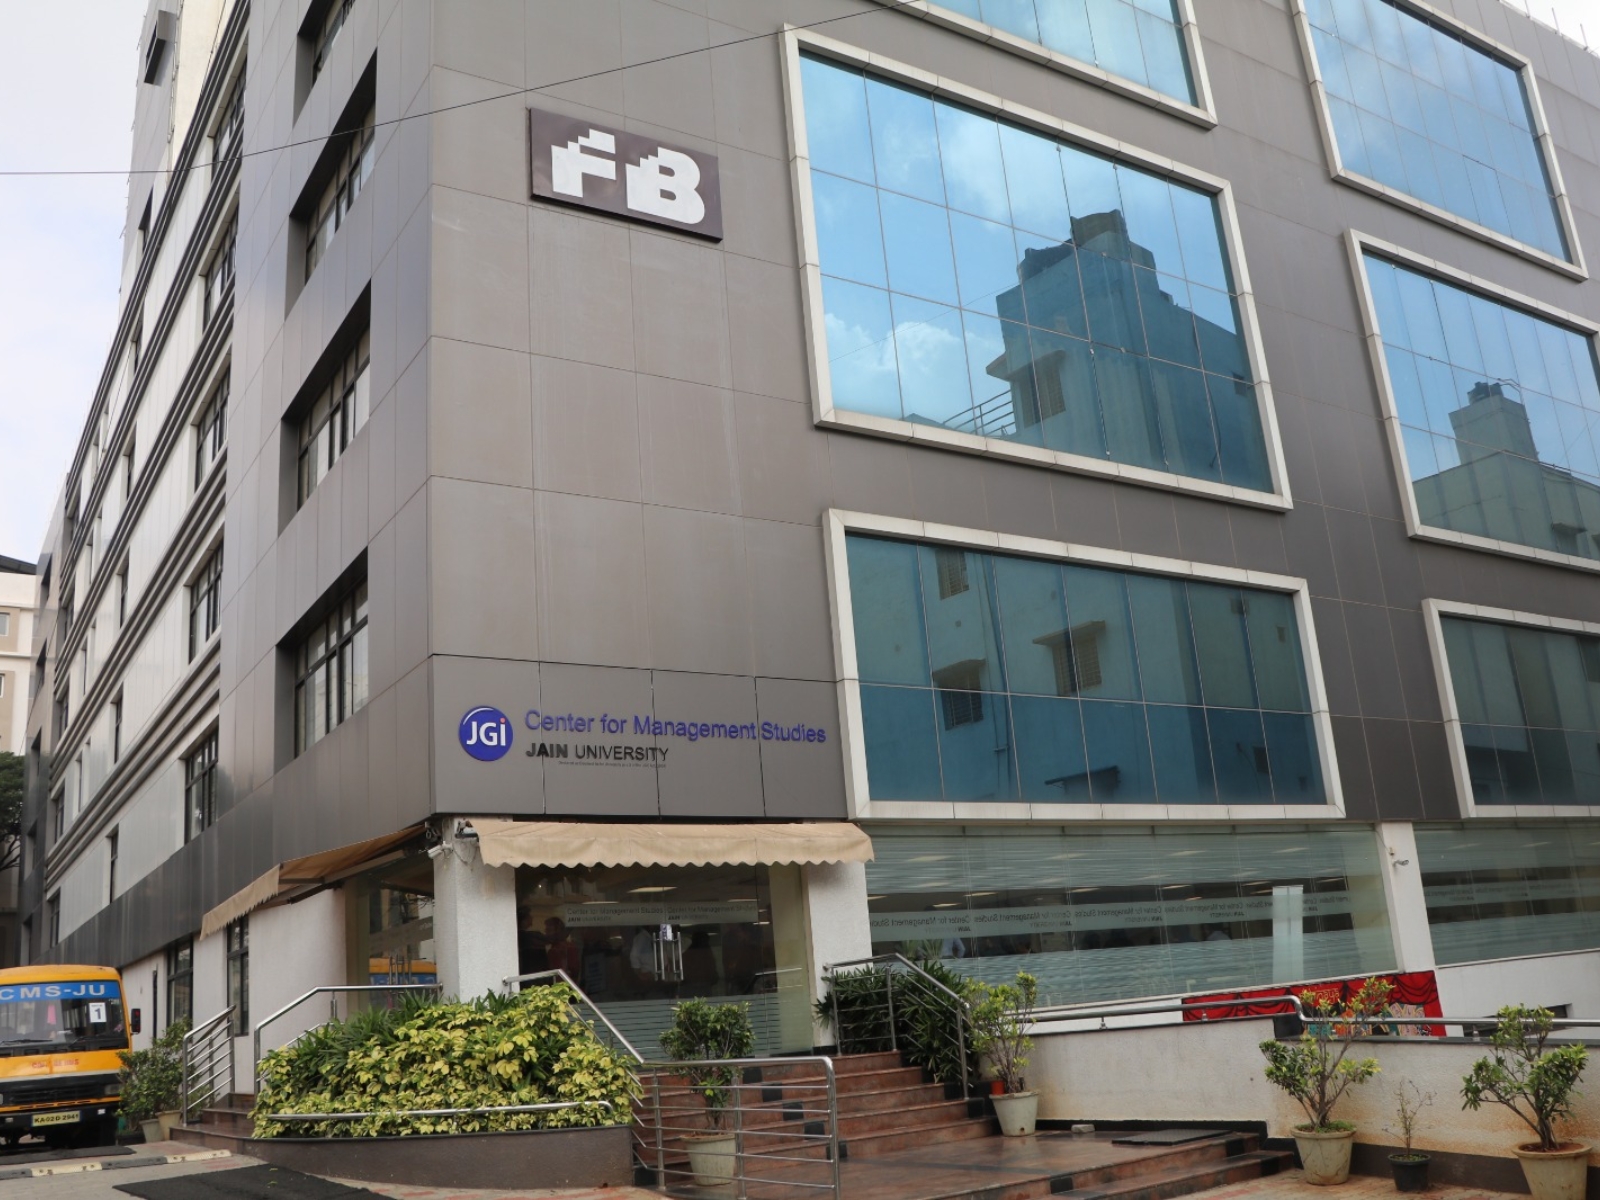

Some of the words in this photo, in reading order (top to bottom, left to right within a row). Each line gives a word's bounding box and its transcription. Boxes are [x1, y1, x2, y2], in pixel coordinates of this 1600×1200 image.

[525, 709, 595, 732] Center
[600, 713, 627, 734] for
[633, 715, 757, 742] Management
[761, 721, 827, 743] Studies
[525, 742, 568, 758] JAIN
[575, 744, 669, 761] UNIVERSITY
[0, 984, 105, 1000] CMS-JU
[94, 1007, 102, 1020] 1
